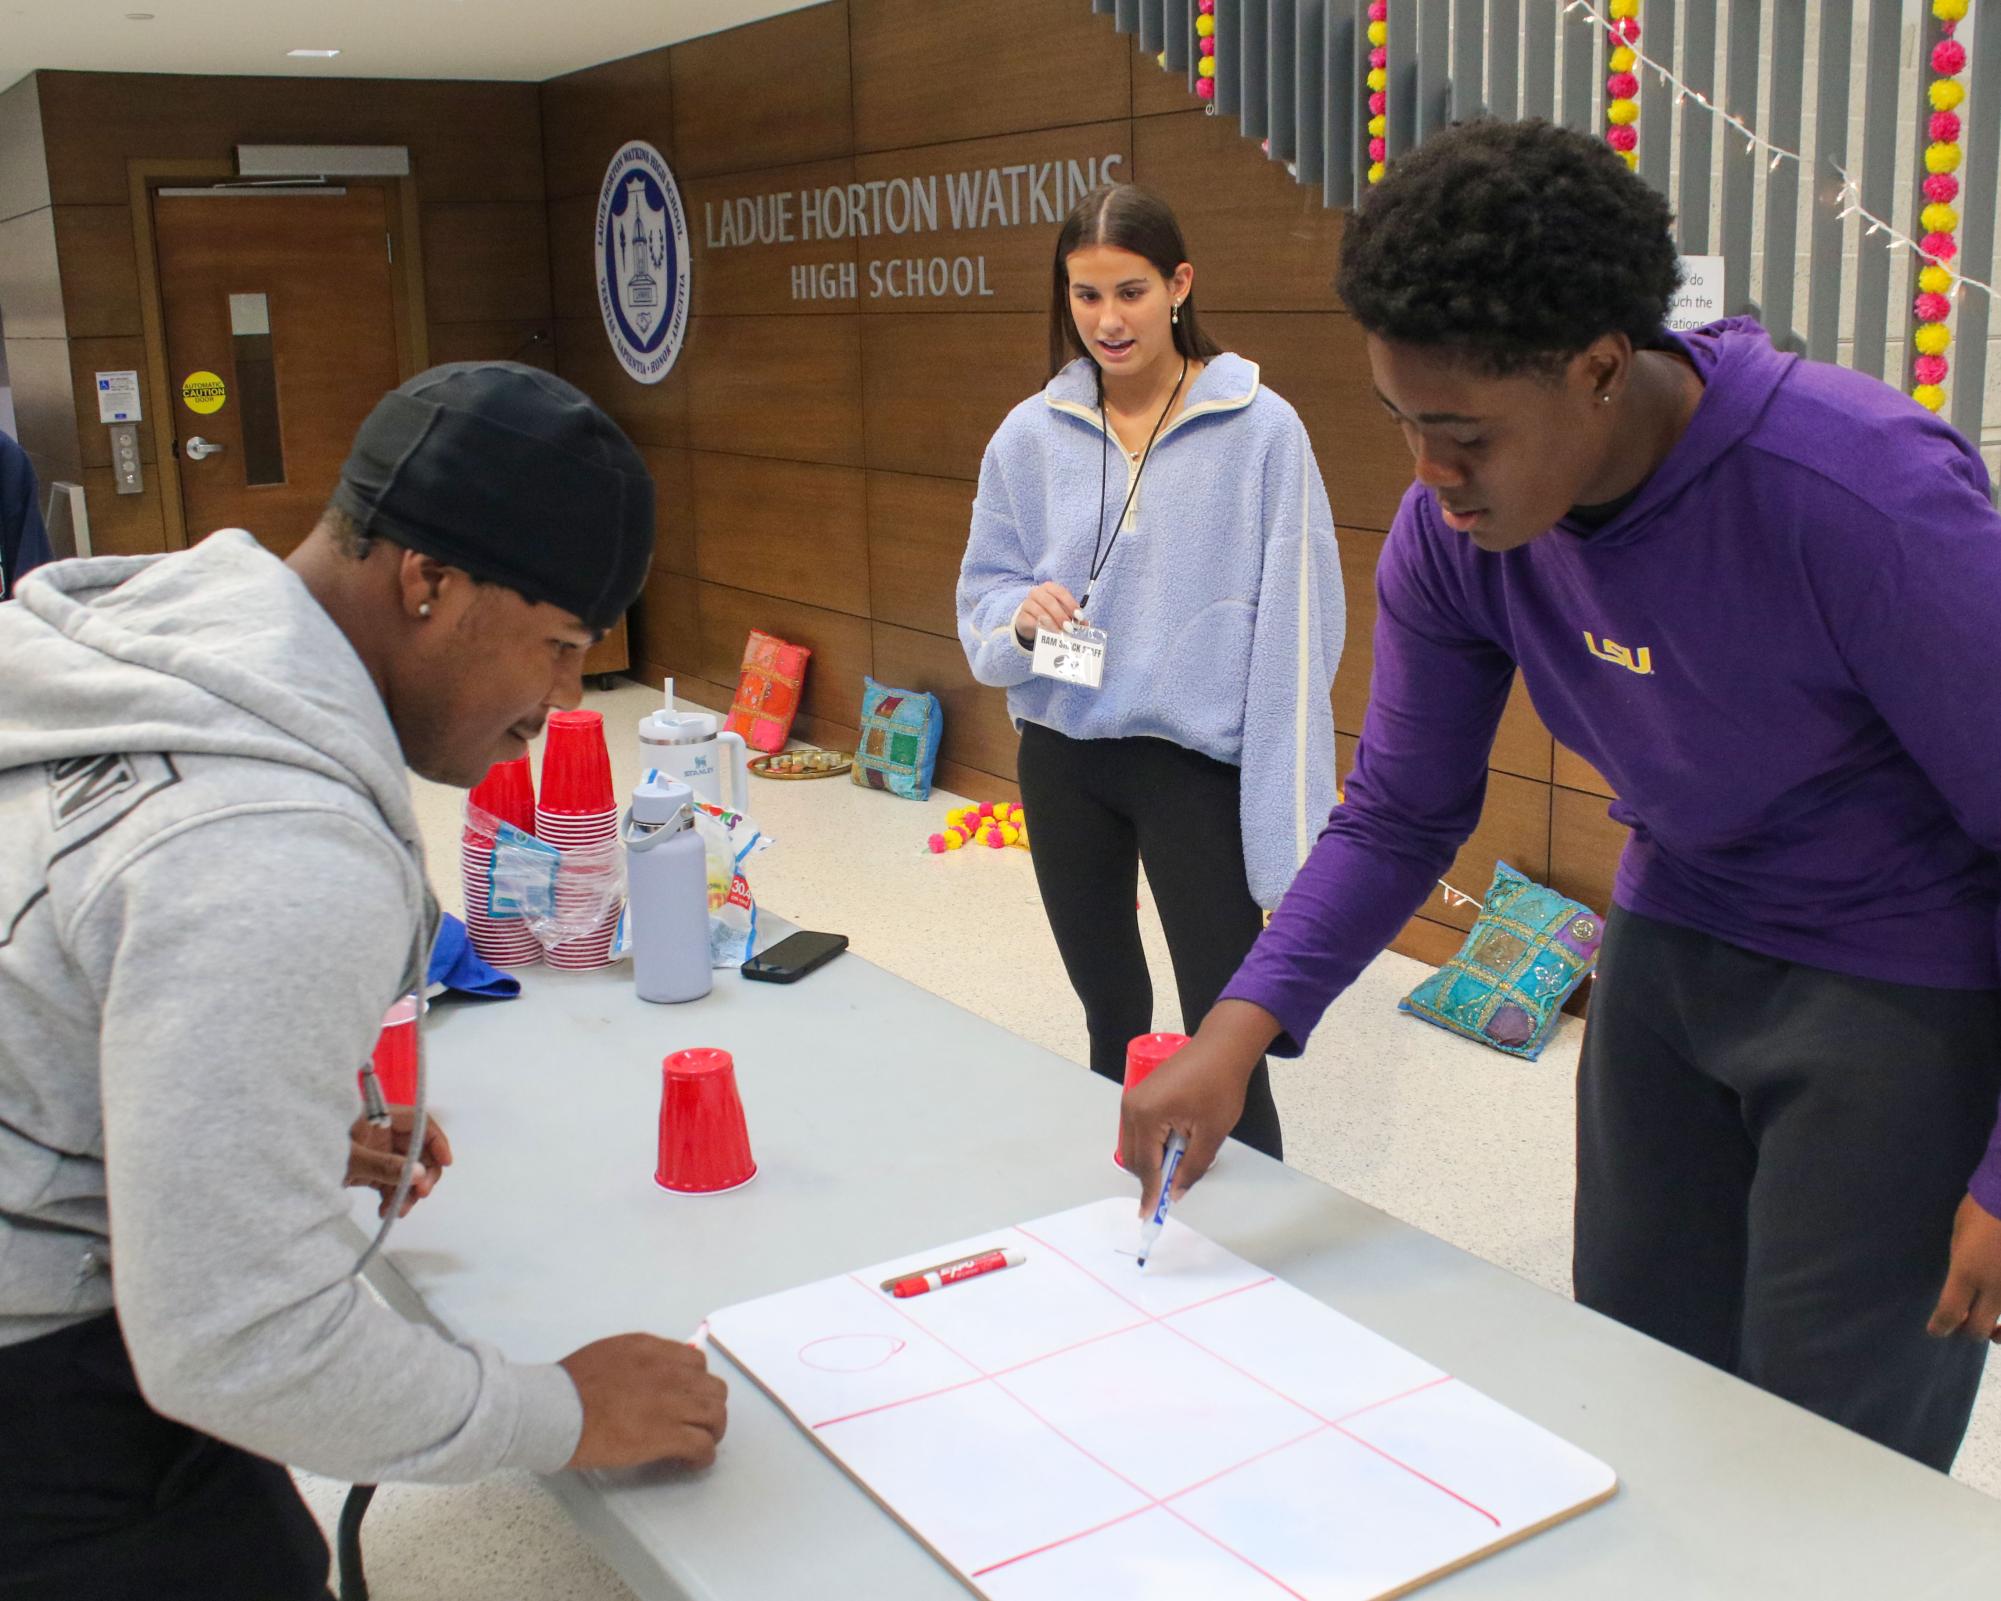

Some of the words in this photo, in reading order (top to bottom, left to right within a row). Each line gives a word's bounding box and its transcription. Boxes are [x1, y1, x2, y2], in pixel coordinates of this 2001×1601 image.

[597, 200, 609, 247] LADUE
[603, 156, 625, 201] HORTON
[622, 147, 651, 162] WATKINS
[649, 154, 667, 185] HIGH
[664, 180, 683, 242] SCHOOL
[704, 192, 794, 248] LADUE
[800, 175, 938, 241] HORTON
[791, 262, 858, 300] HIGH
[868, 256, 994, 298] SCHOOL
[1689, 273, 1704, 286] do
[1672, 295, 1692, 308] uch
[1695, 296, 1713, 309] the
[600, 277, 616, 335] VERITAS
[650, 344, 673, 374] HONOR
[182, 388, 225, 398] CAUTION
[1041, 635, 1058, 647] RAM
[1583, 631, 1651, 675] LSU
